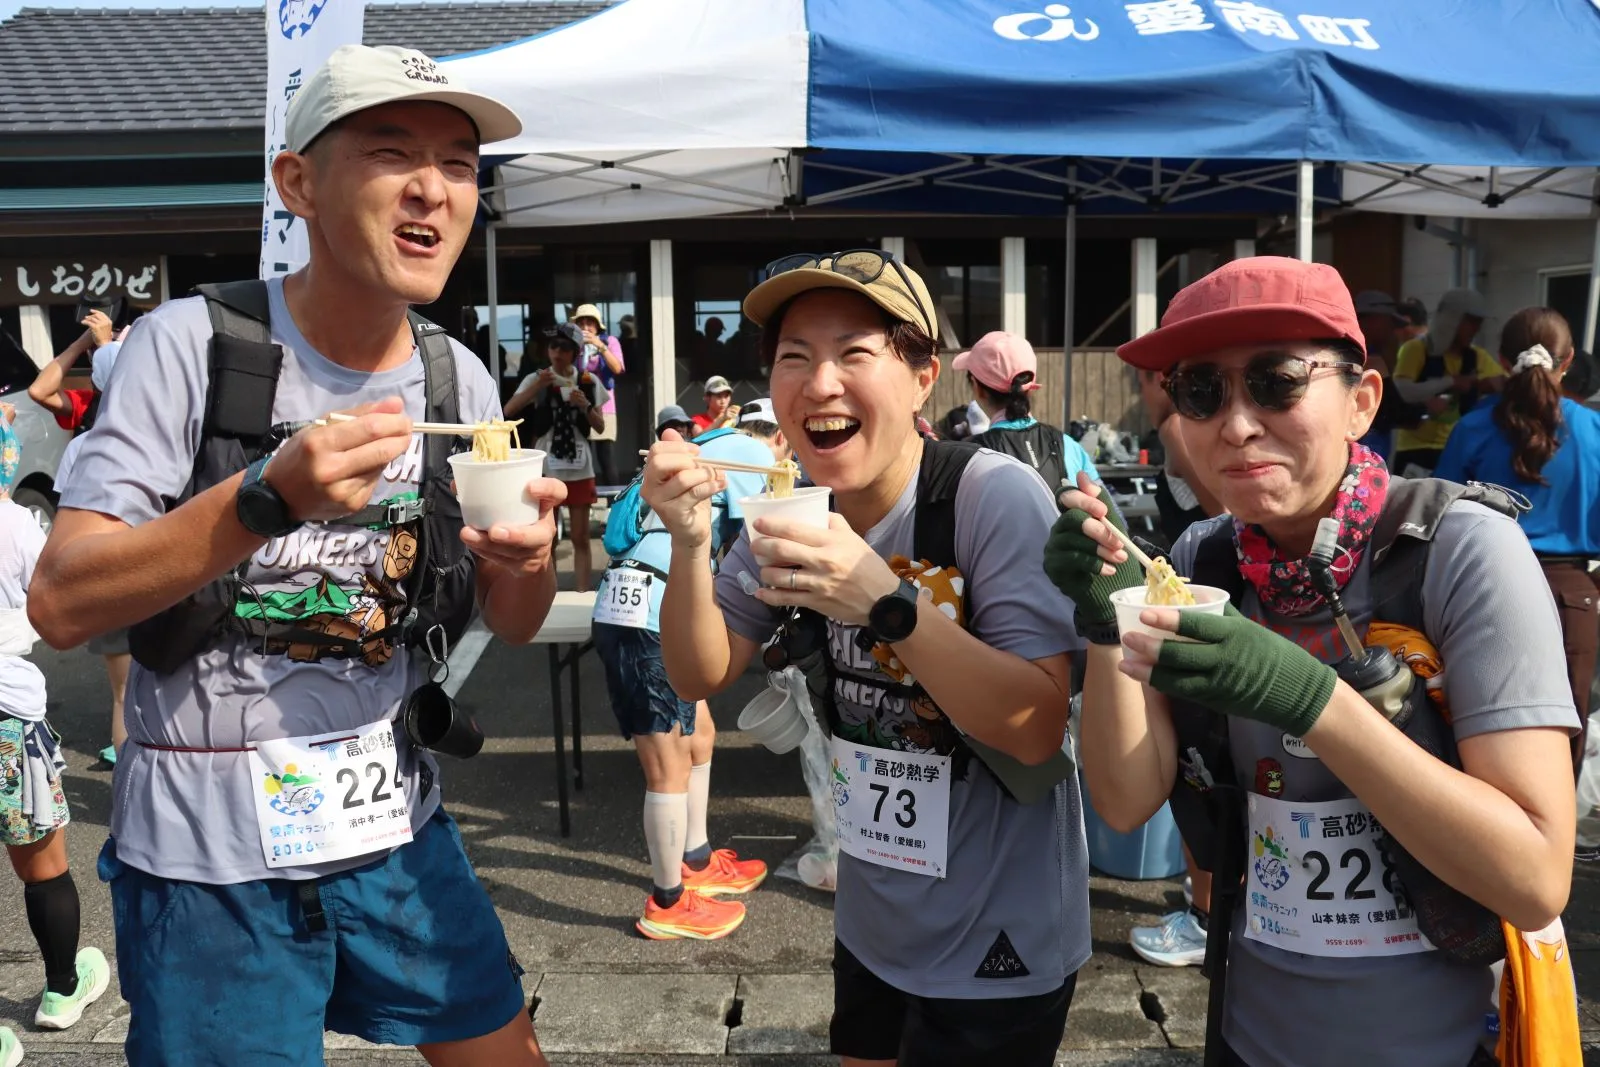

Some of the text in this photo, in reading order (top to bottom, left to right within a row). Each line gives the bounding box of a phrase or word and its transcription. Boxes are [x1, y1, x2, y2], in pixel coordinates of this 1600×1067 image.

[1123, 0, 1381, 50] 愛南町
[16, 262, 157, 299] しおかぜ
[256, 531, 390, 569] UNNERS
[611, 585, 642, 606] 155
[827, 623, 872, 669] AIL
[834, 677, 906, 714] NNERS
[874, 758, 940, 783] 高砂熱学
[869, 782, 917, 828] 73
[1253, 912, 1281, 935] 026
